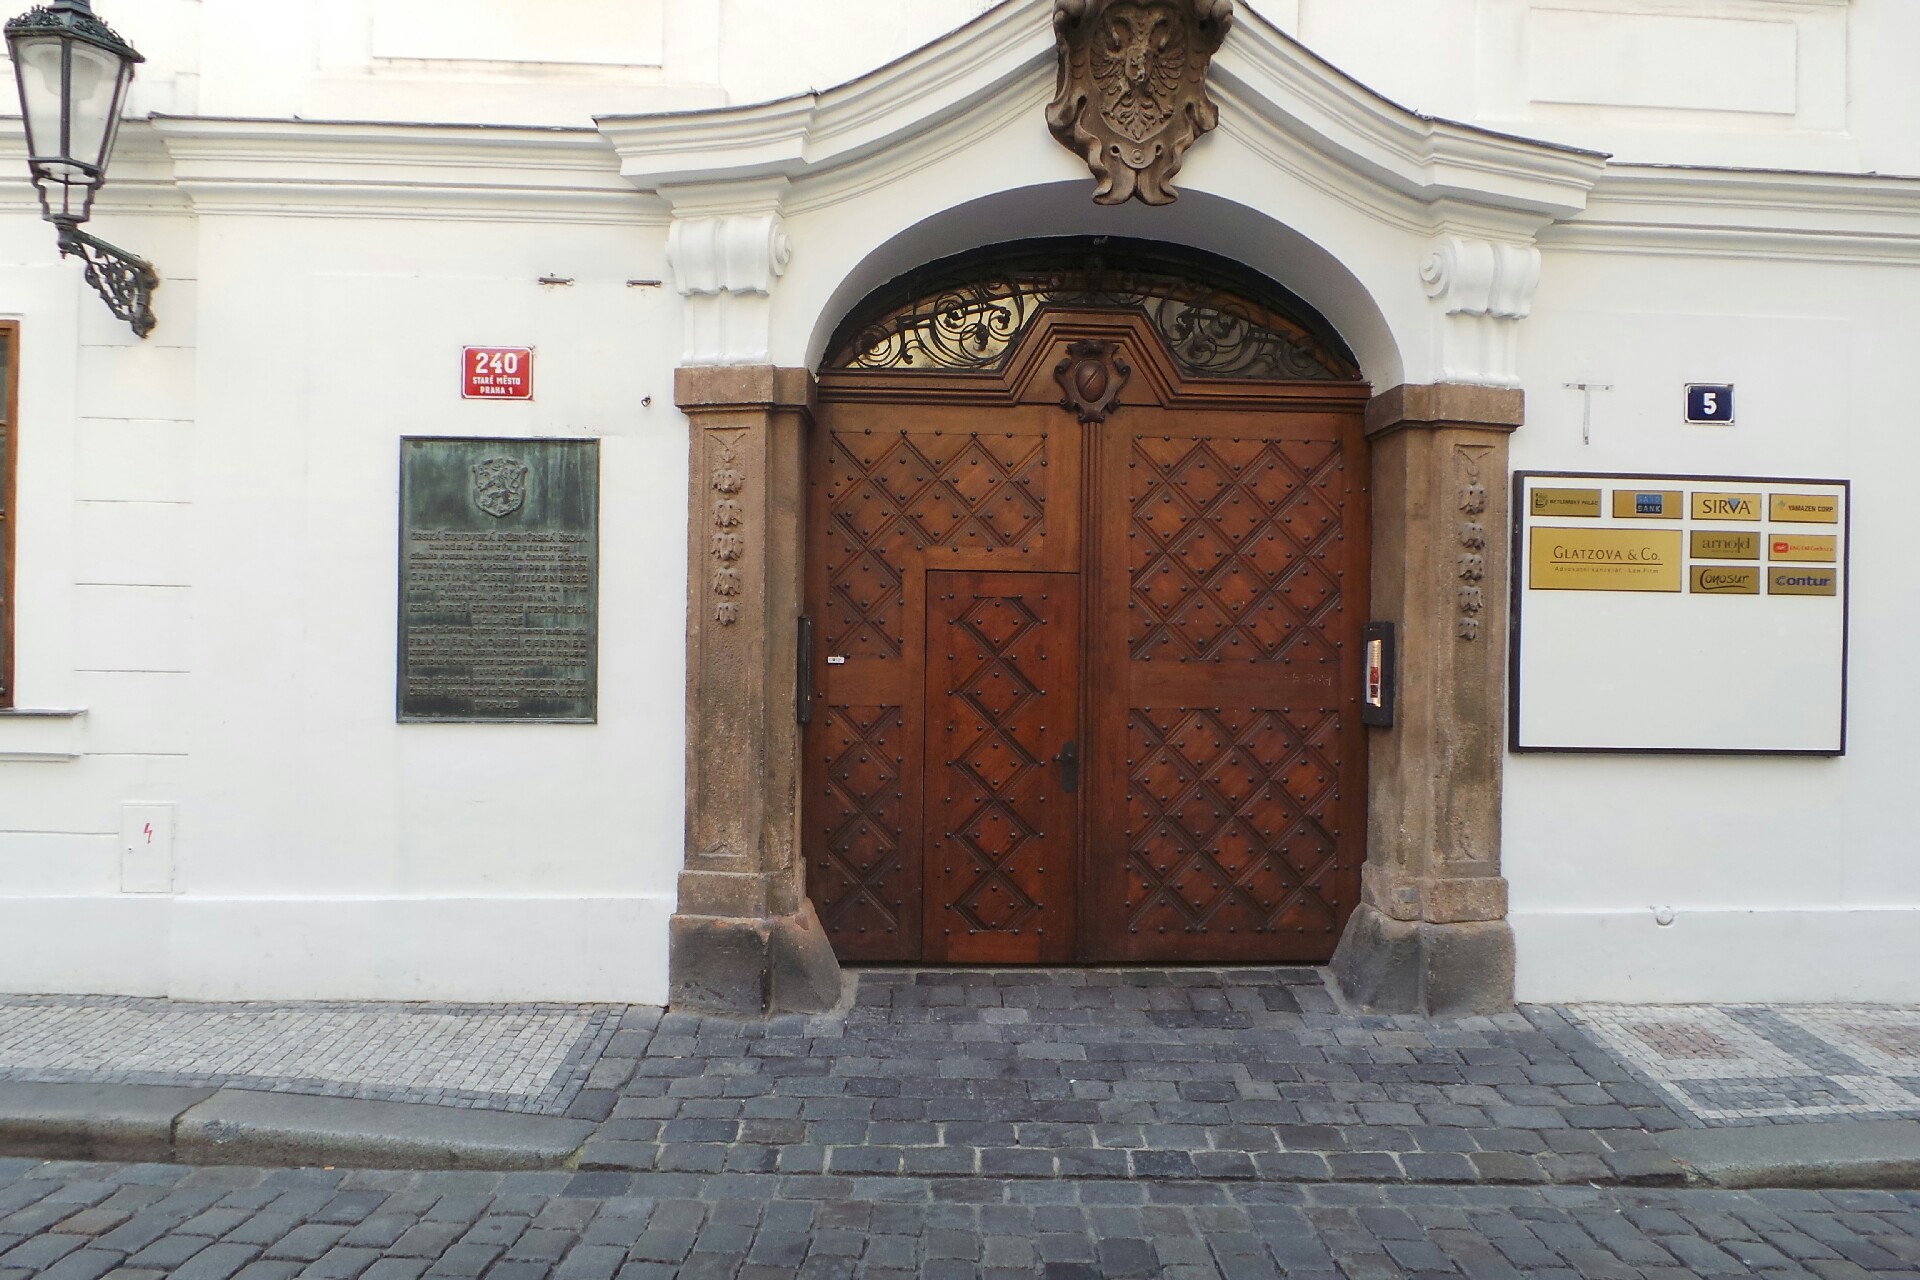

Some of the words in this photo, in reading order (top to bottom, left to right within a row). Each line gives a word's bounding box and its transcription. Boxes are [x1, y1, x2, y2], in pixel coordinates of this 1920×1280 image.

[475, 352, 518, 374] 240
[472, 375, 494, 385] STARÉ
[496, 375, 521, 385] MĚSTO
[480, 386, 506, 394] PRAHA
[508, 386, 513, 394] 1
[1703, 392, 1717, 415] 5
[1788, 504, 1816, 512] YAMAZEN
[1702, 537, 1750, 553] arnold
[1627, 548, 1638, 561] &
[476, 573, 511, 582] JOSEF
